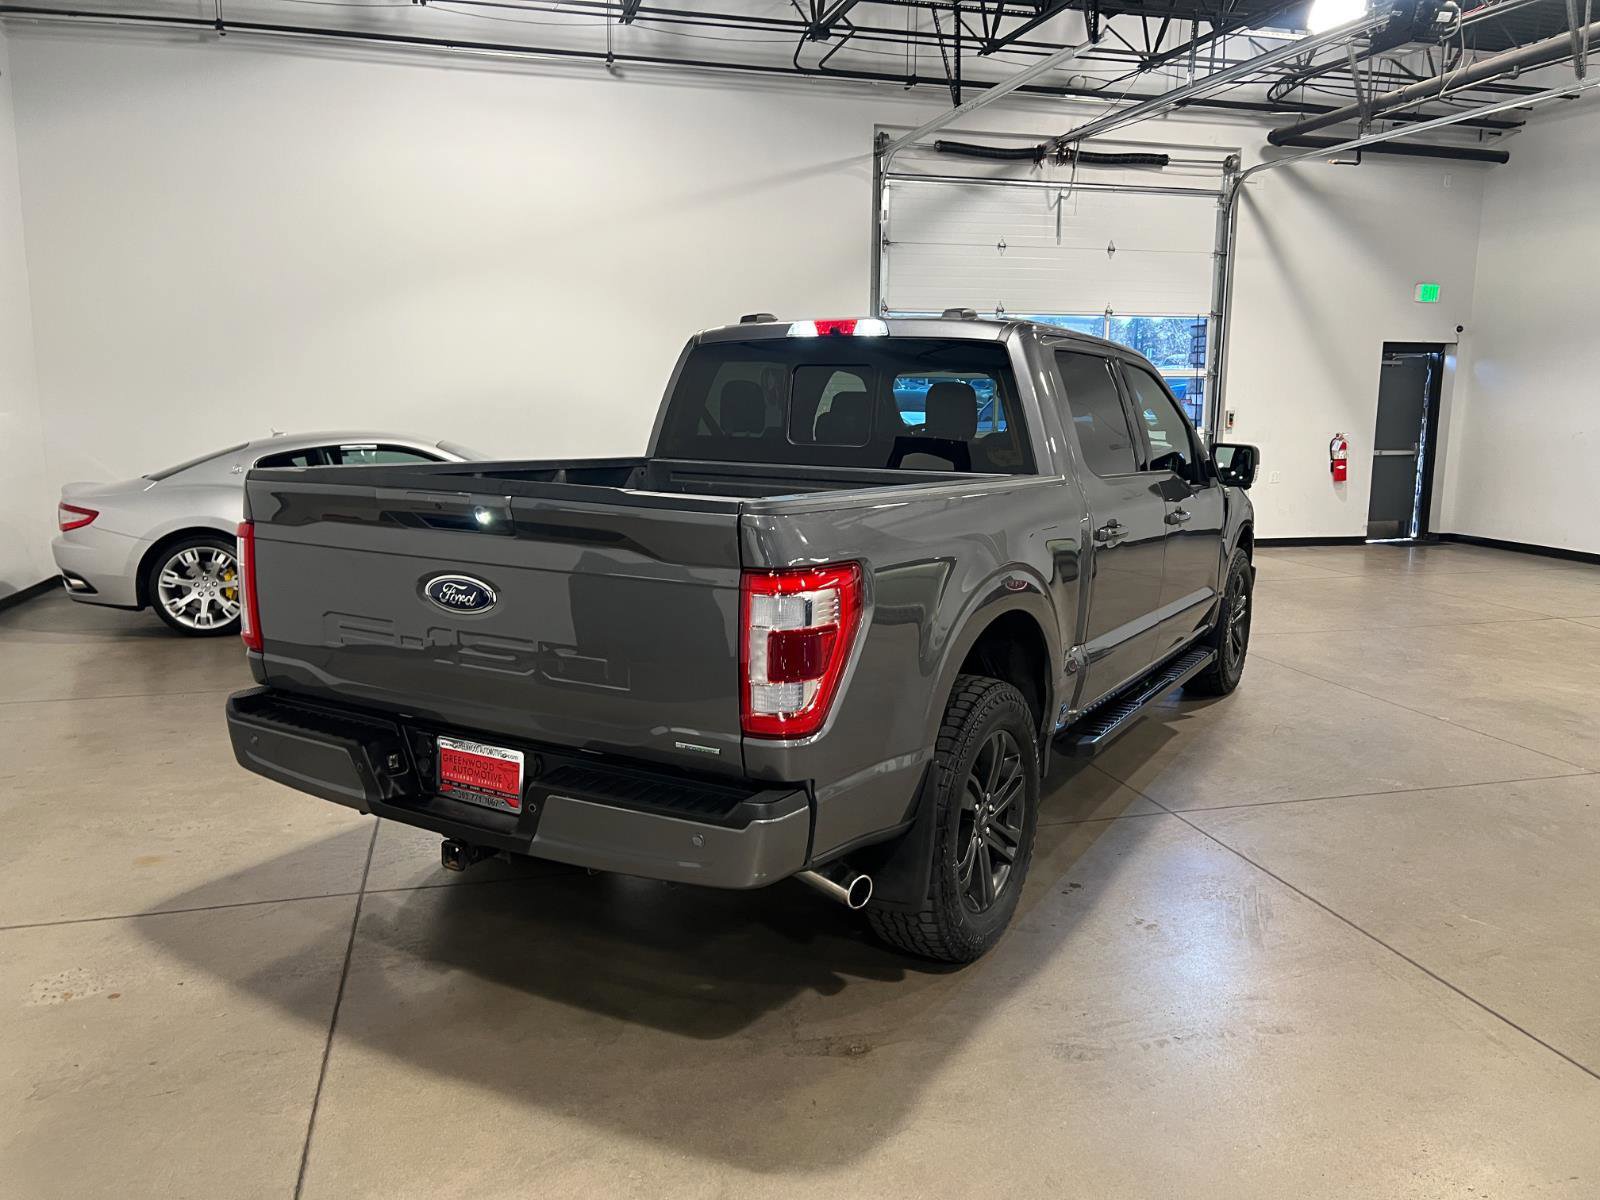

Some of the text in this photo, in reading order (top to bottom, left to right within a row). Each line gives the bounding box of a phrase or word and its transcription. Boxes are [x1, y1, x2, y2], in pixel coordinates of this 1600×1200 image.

[439, 582, 477, 606] Ford
[443, 754, 495, 771] GREENWOOD
[453, 765, 503, 783] AUTOMOTIVE
